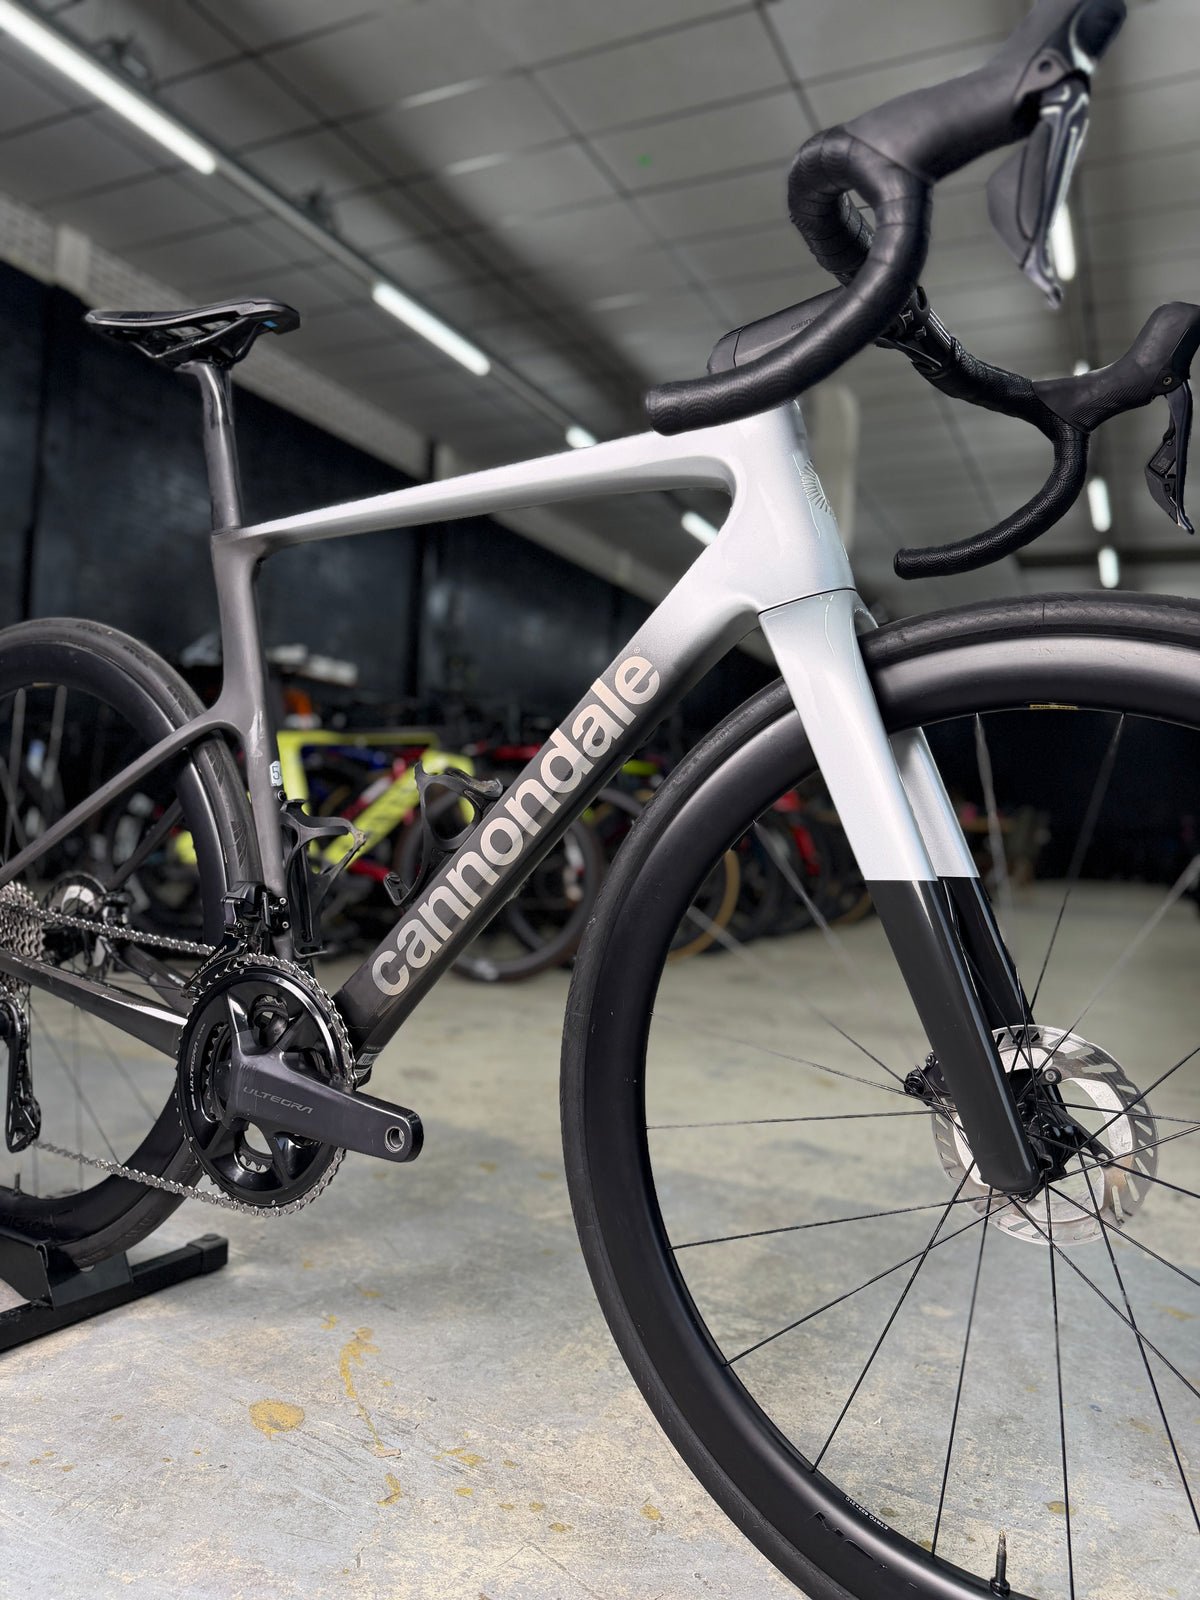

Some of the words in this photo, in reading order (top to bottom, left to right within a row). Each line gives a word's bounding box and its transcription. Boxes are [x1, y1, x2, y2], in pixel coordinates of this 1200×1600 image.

[371, 655, 661, 996] cannondale
[198, 944, 228, 974] ULTEGRA
[189, 1041, 199, 1092] ULTEGRA
[243, 1086, 314, 1115] ULTEGRA
